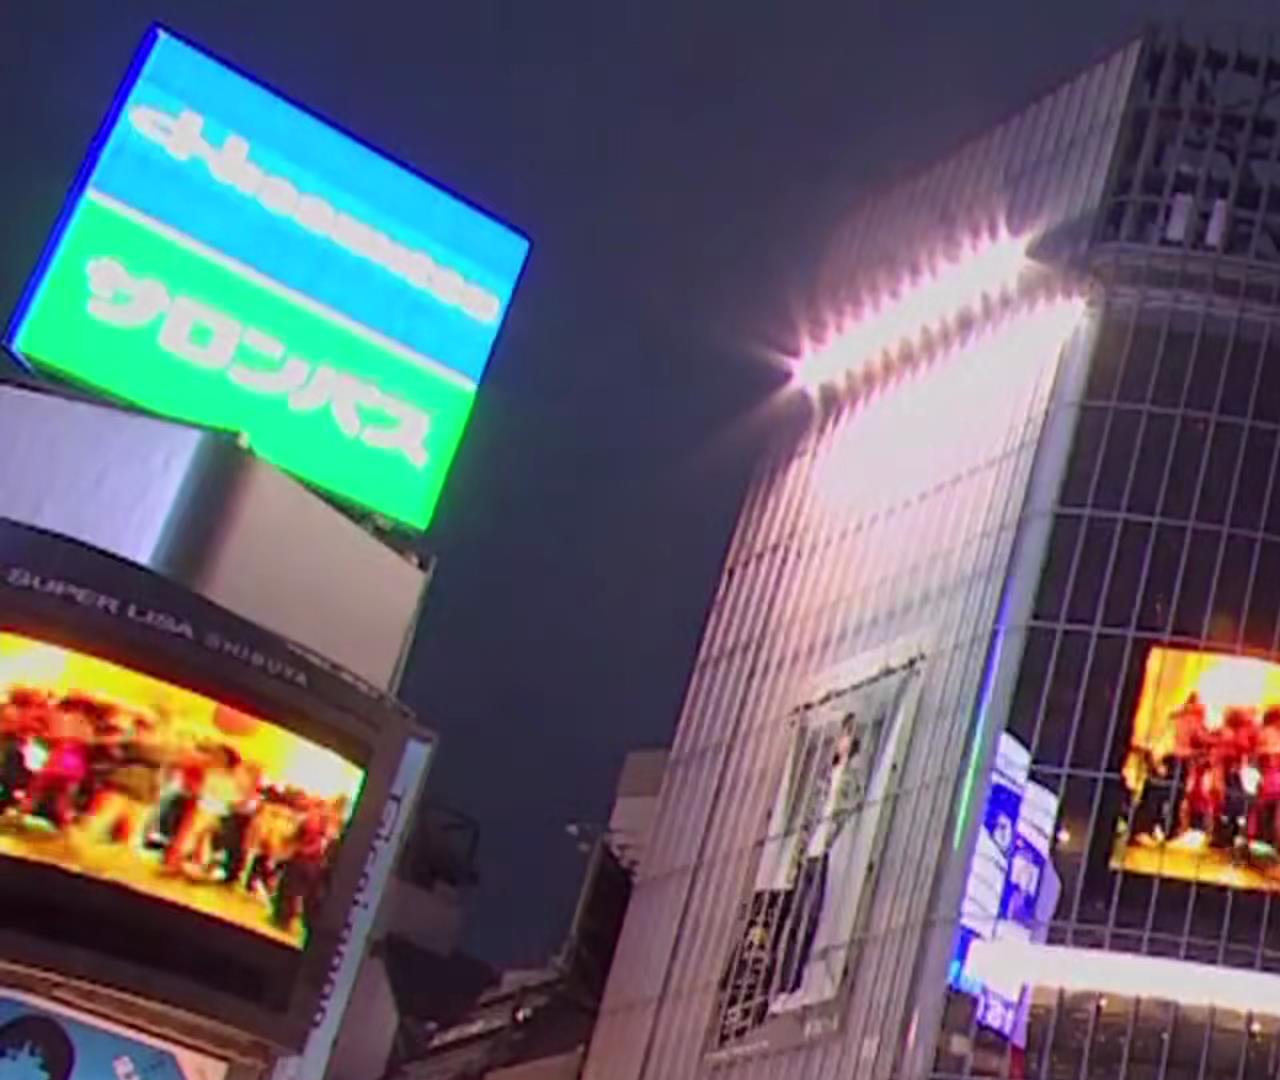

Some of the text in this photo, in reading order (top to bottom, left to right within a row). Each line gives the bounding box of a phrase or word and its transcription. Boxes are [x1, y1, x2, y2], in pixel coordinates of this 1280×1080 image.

[86, 256, 432, 470] サロンパス
